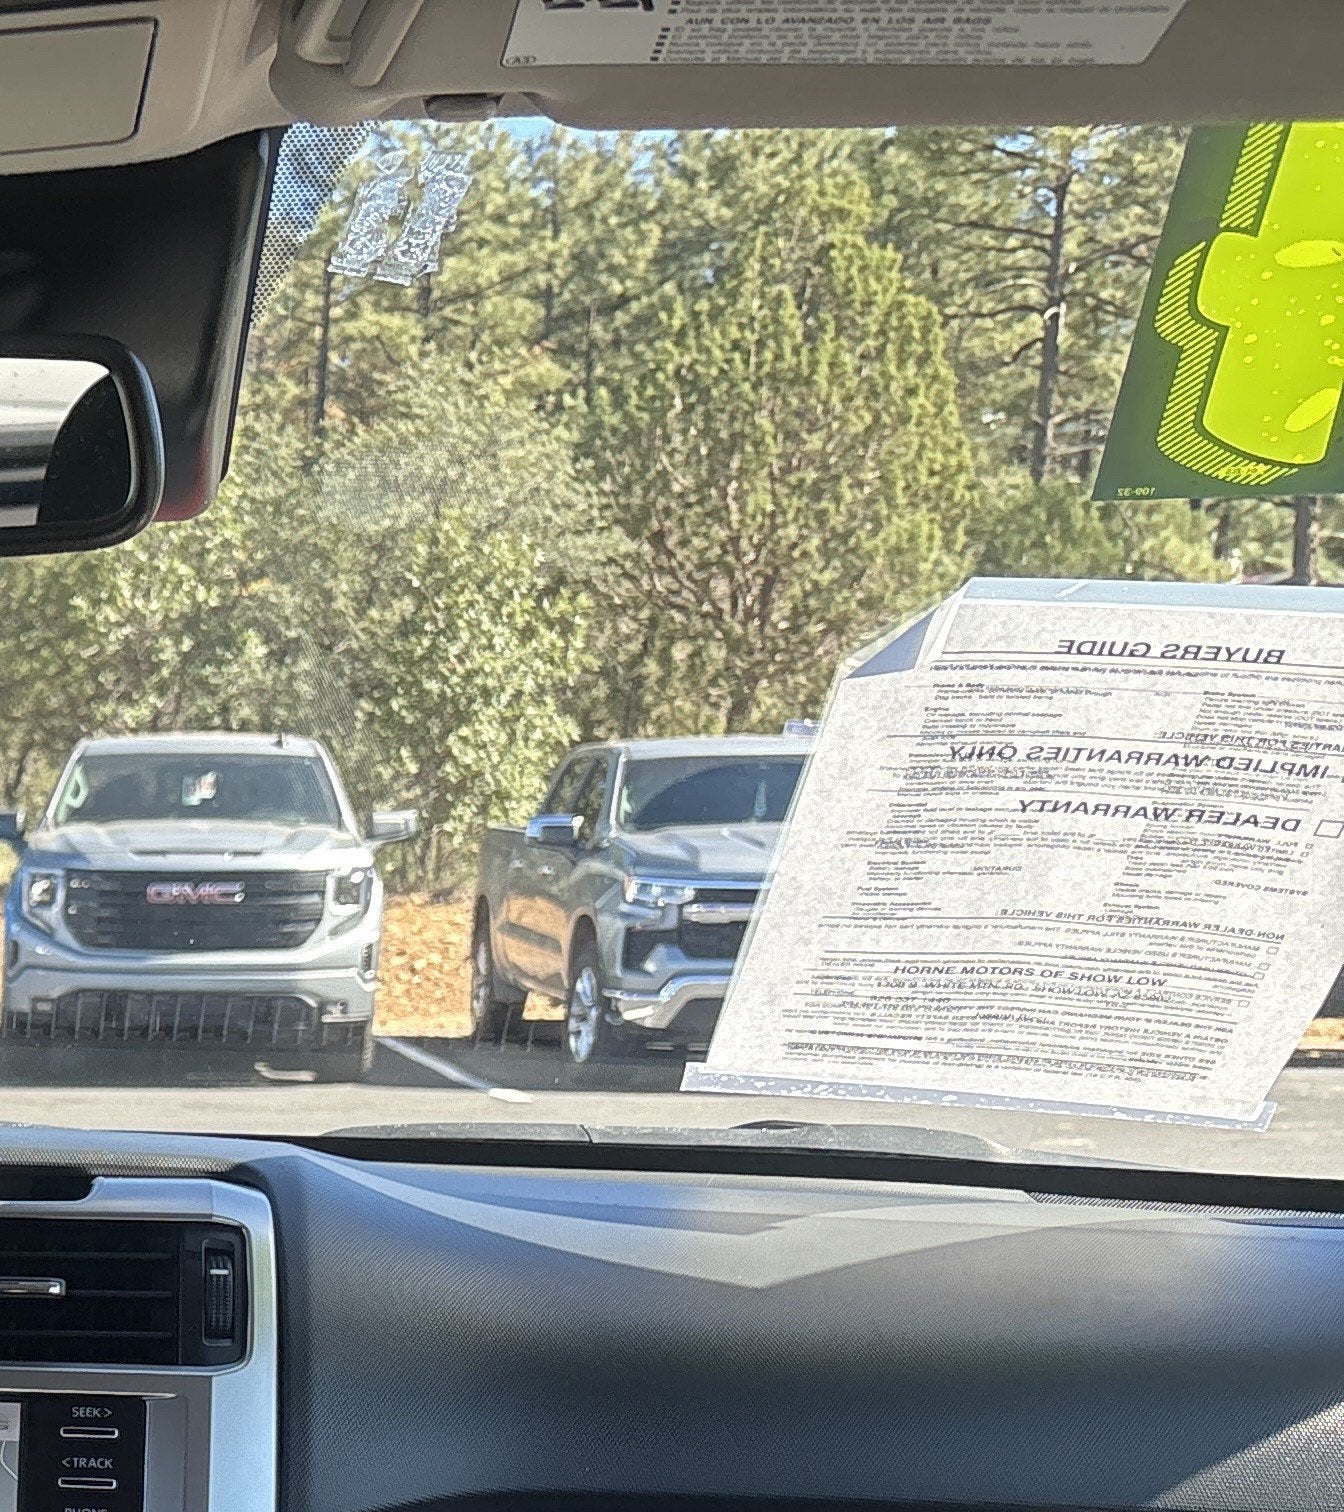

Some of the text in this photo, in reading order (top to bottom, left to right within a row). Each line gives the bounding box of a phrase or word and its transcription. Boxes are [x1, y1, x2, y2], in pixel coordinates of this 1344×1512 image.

[146, 881, 245, 904] GMC
[893, 965, 1168, 987] HORNE MOTORS OF SHOW LOW
[72, 1407, 101, 1418] SEEK
[72, 1458, 113, 1470] TRACK
